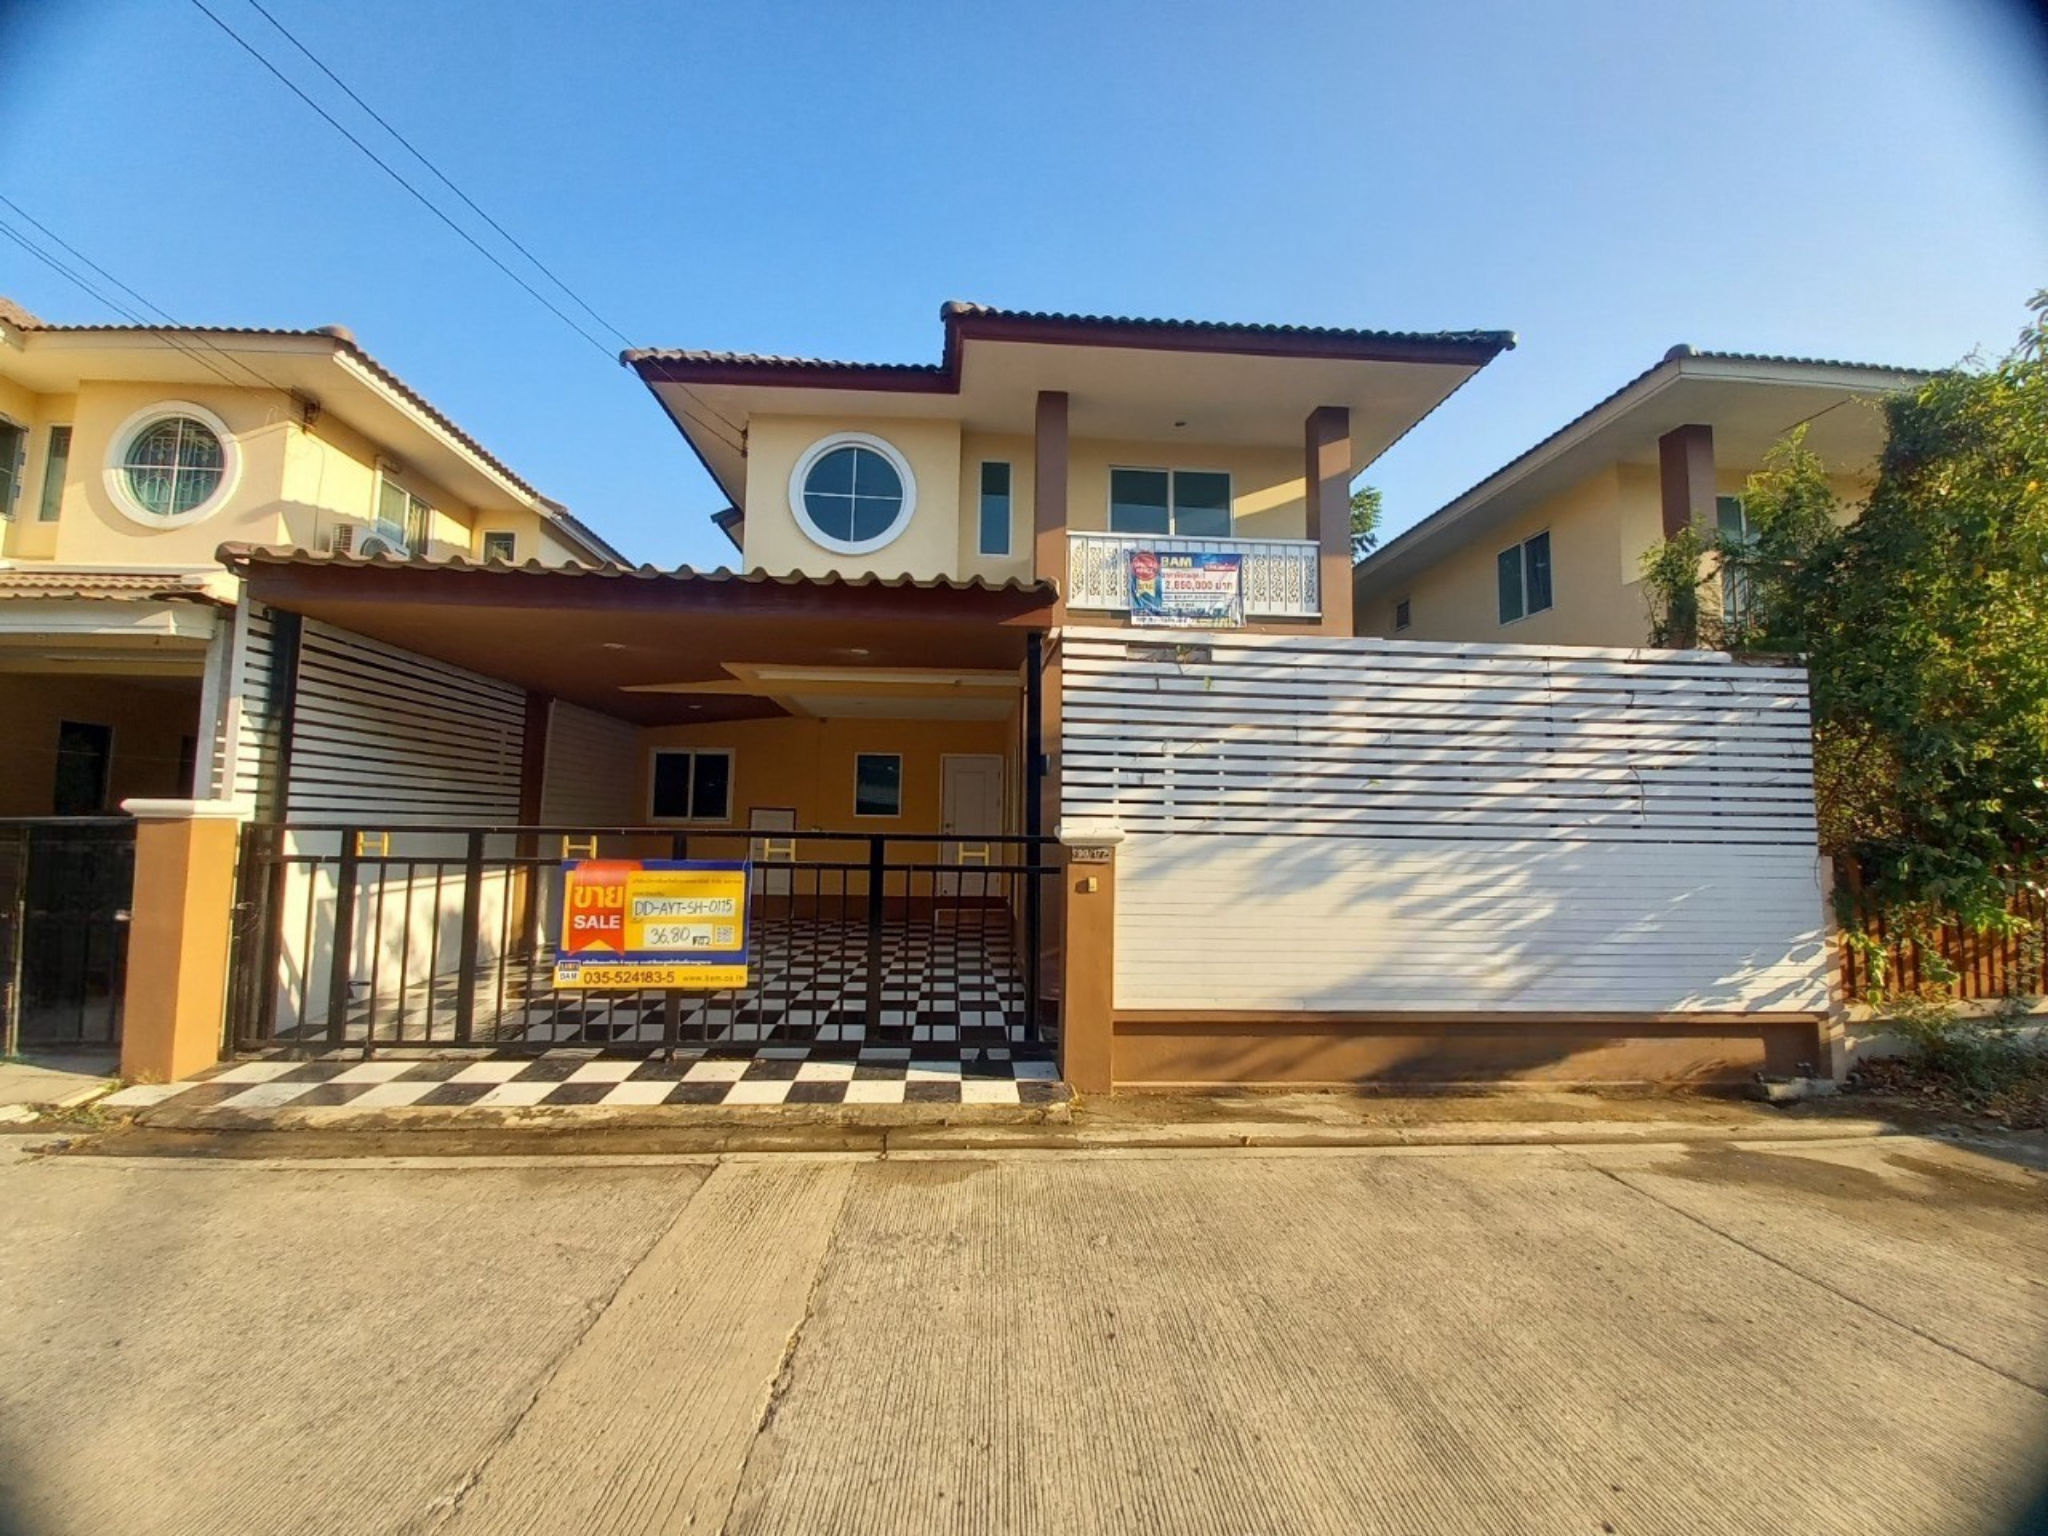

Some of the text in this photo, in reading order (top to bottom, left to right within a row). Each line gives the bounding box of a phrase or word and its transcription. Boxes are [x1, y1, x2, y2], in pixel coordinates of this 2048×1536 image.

[1161, 556, 1192, 568] BAM
[574, 885, 625, 908] ขาย
[574, 915, 621, 929] SALE
[650, 927, 691, 945] 36.80
[583, 971, 675, 985] 035-524183-5
